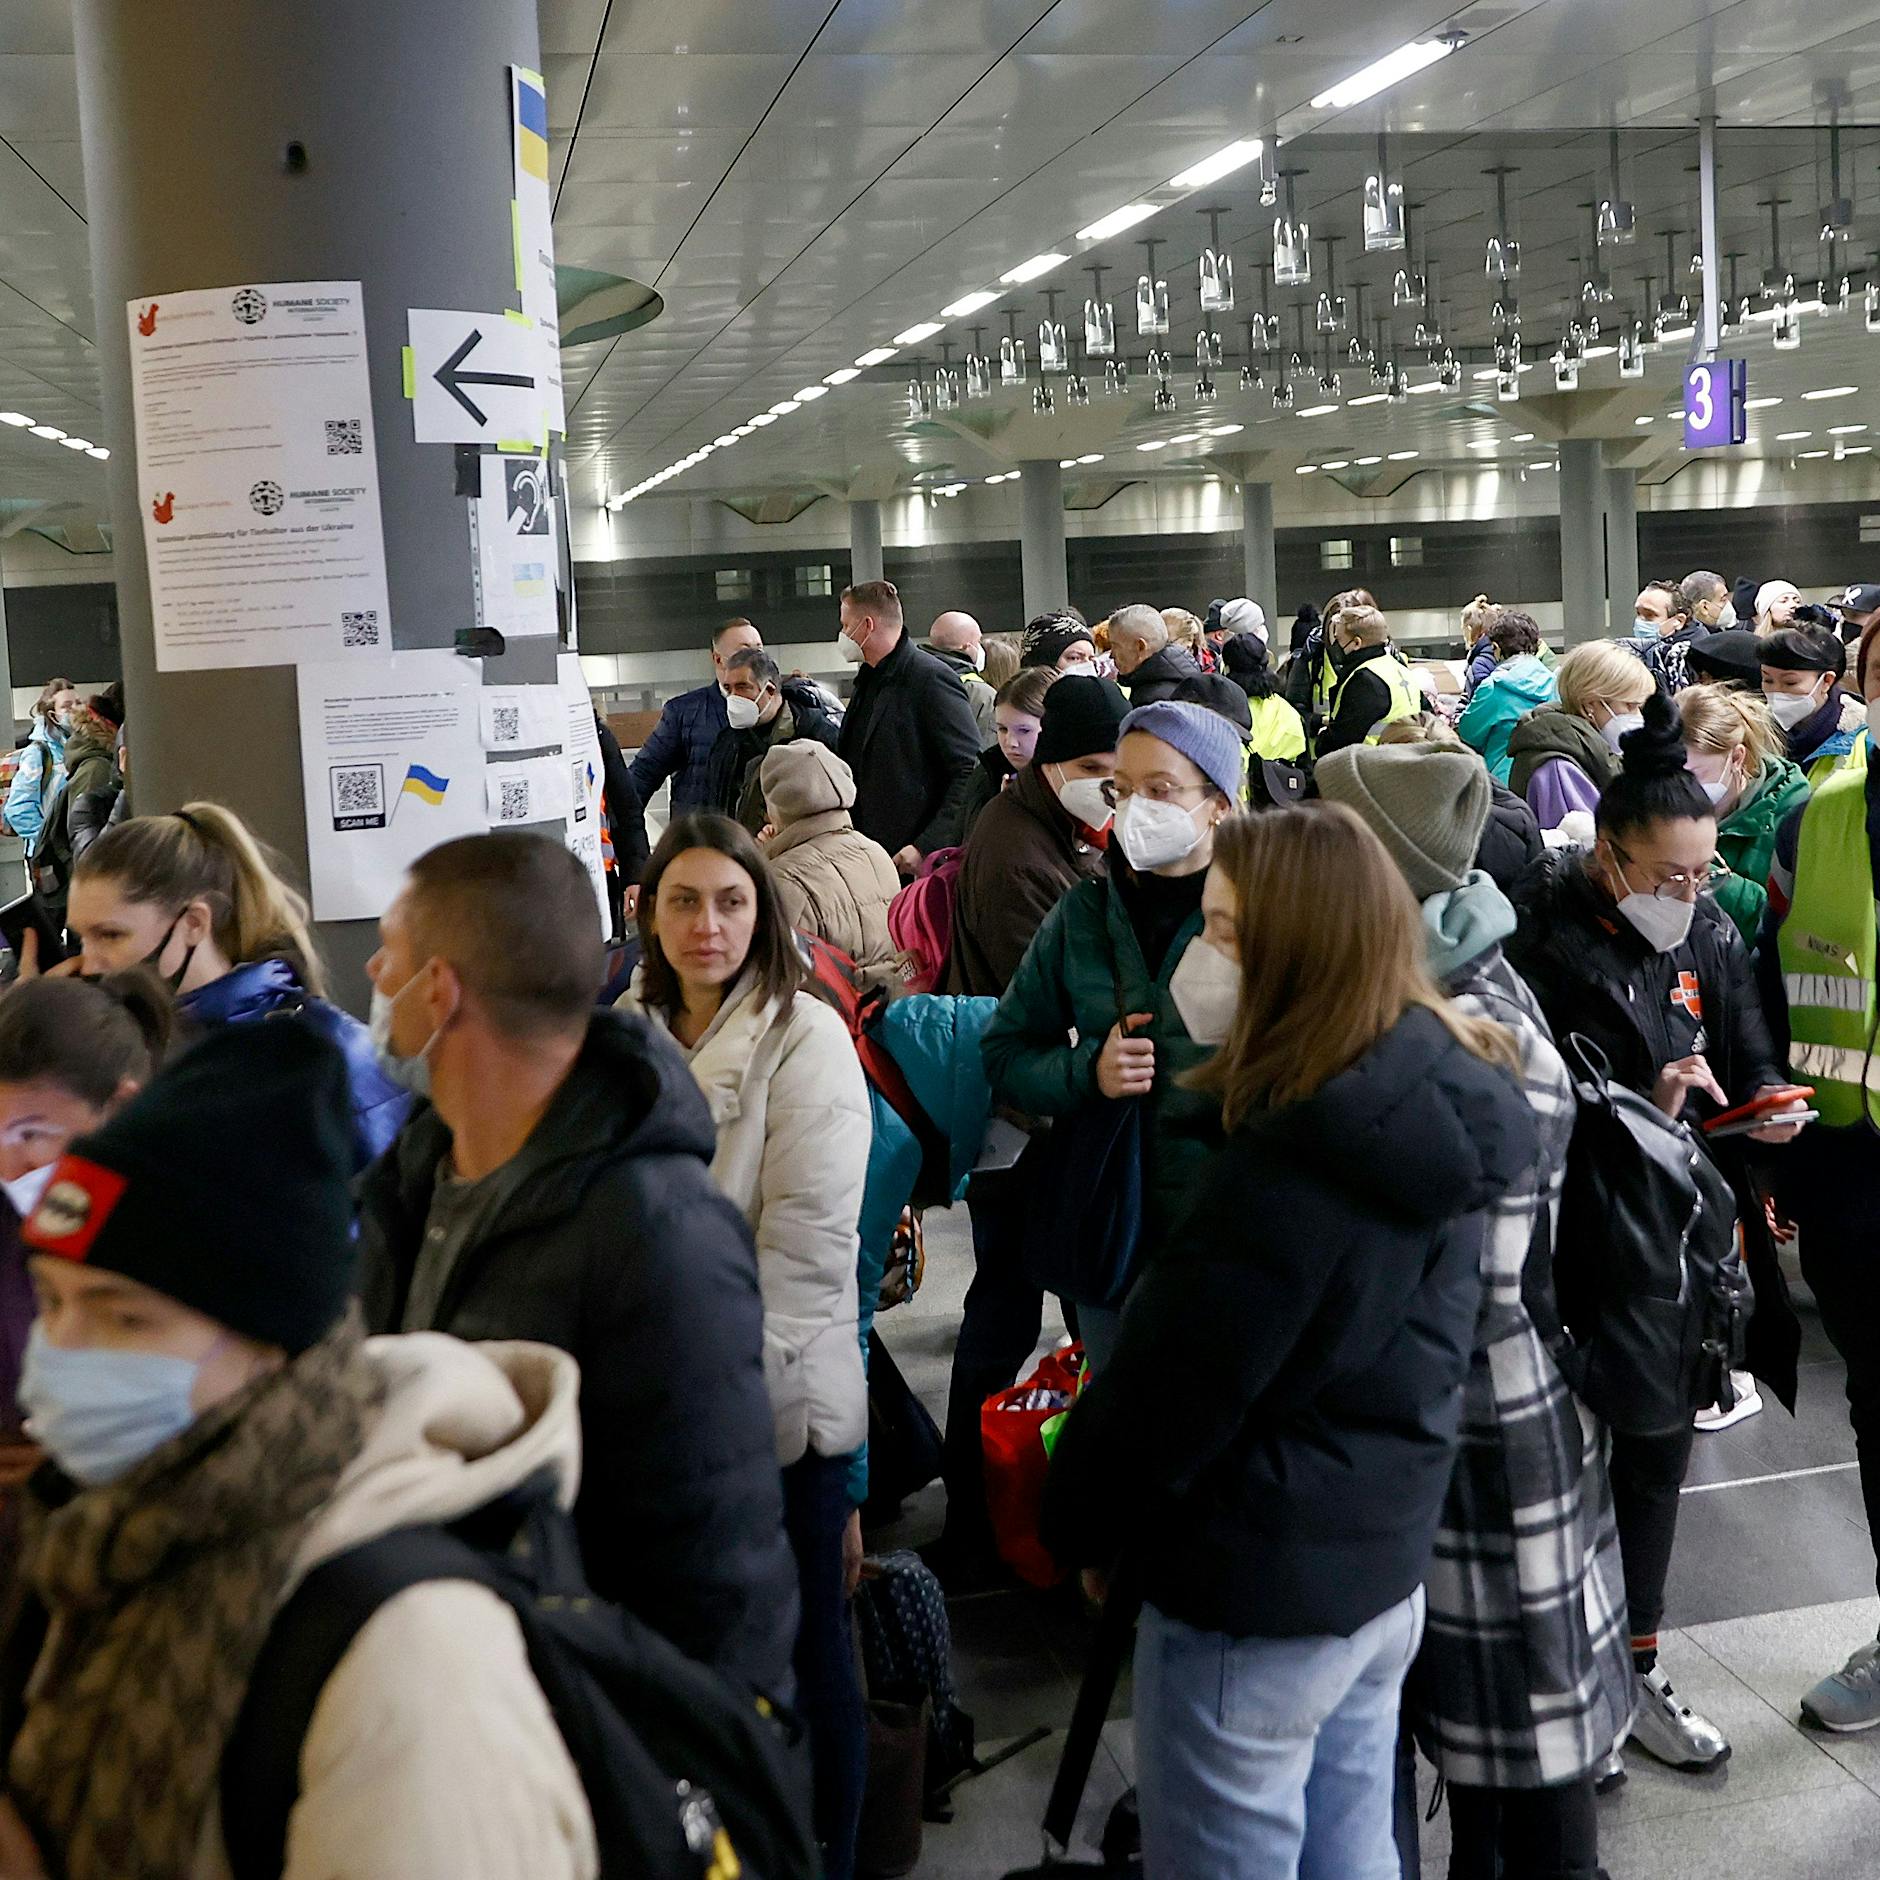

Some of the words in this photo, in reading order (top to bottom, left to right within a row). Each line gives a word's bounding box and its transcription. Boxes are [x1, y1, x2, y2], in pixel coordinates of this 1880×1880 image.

[273, 299, 313, 307] HUMANE
[316, 297, 350, 306] SOCIETY
[1688, 366, 1714, 431] 3
[289, 489, 331, 499] HUMANE
[332, 487, 367, 497] SOCIETY
[306, 524, 319, 532] der
[321, 522, 355, 532] Ukraine
[340, 817, 365, 829] SCAN
[365, 816, 380, 827] ME
